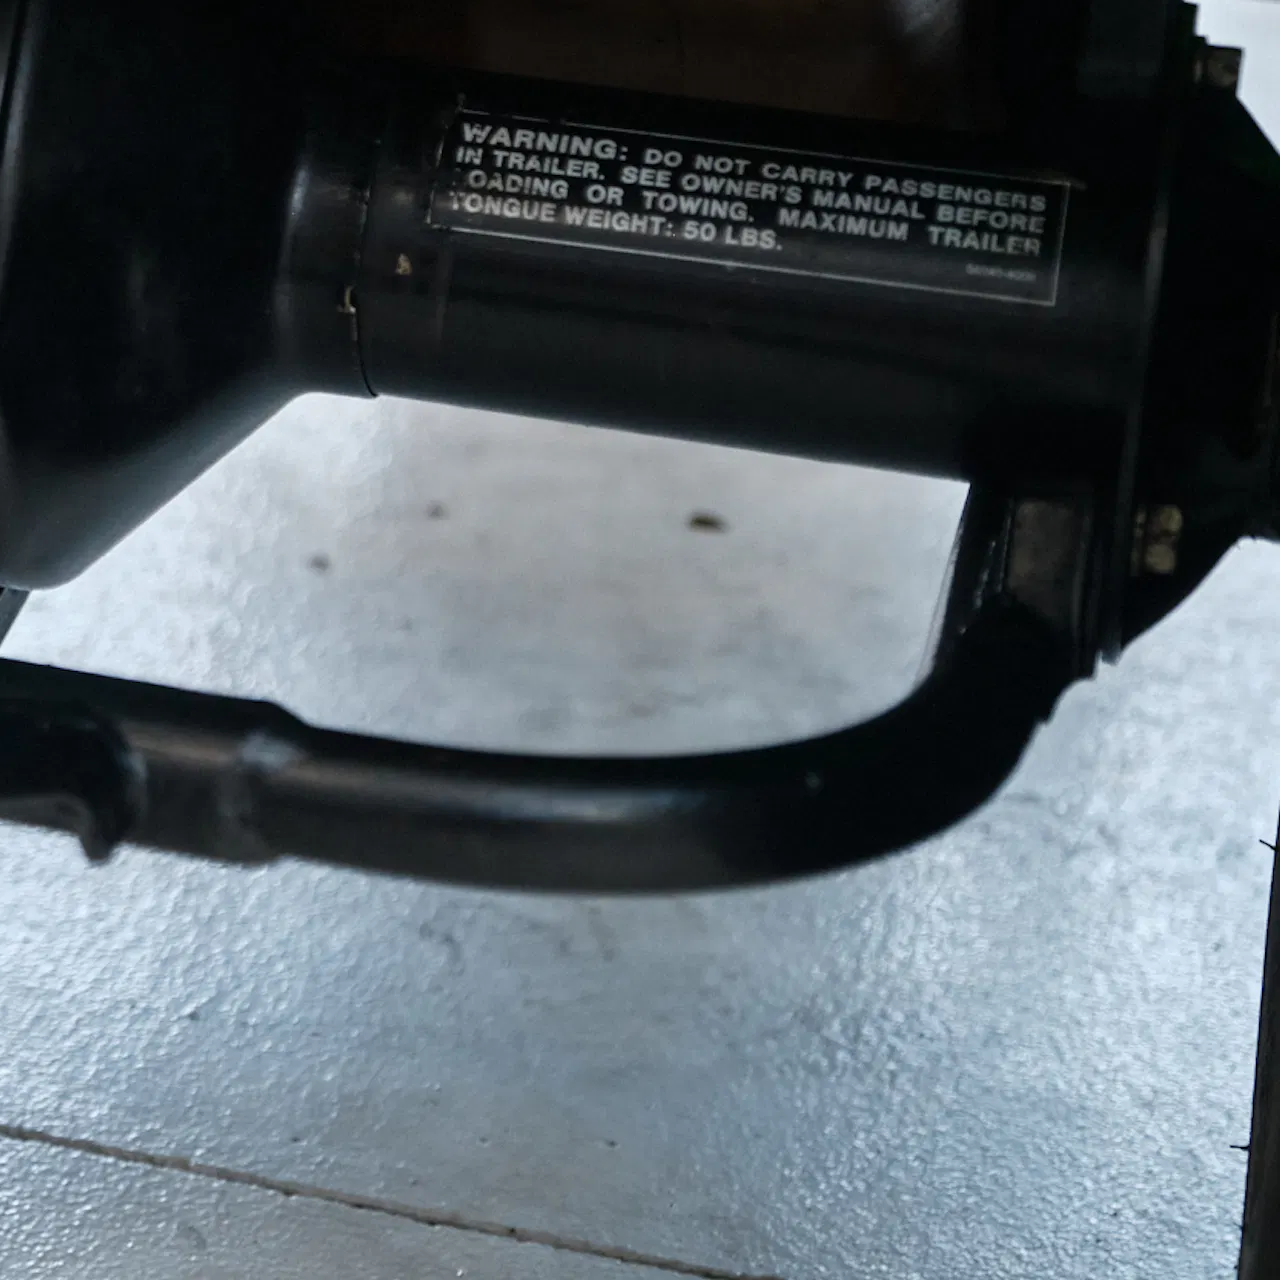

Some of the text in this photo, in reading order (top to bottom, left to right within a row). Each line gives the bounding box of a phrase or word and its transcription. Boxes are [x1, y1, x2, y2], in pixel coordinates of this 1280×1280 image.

[455, 146, 1046, 234] IN TRAILER. SEE OWNER'S MANUAL BEFORE
[461, 122, 1047, 213] WARNING: DO NOT CARRY PASSENGERS
[453, 167, 1042, 258] OADING OR TOWING. MAXIMUM TRAILER
[562, 205, 674, 237] WEIGHT:
[683, 220, 717, 242] 50
[725, 225, 784, 252] LBS.
